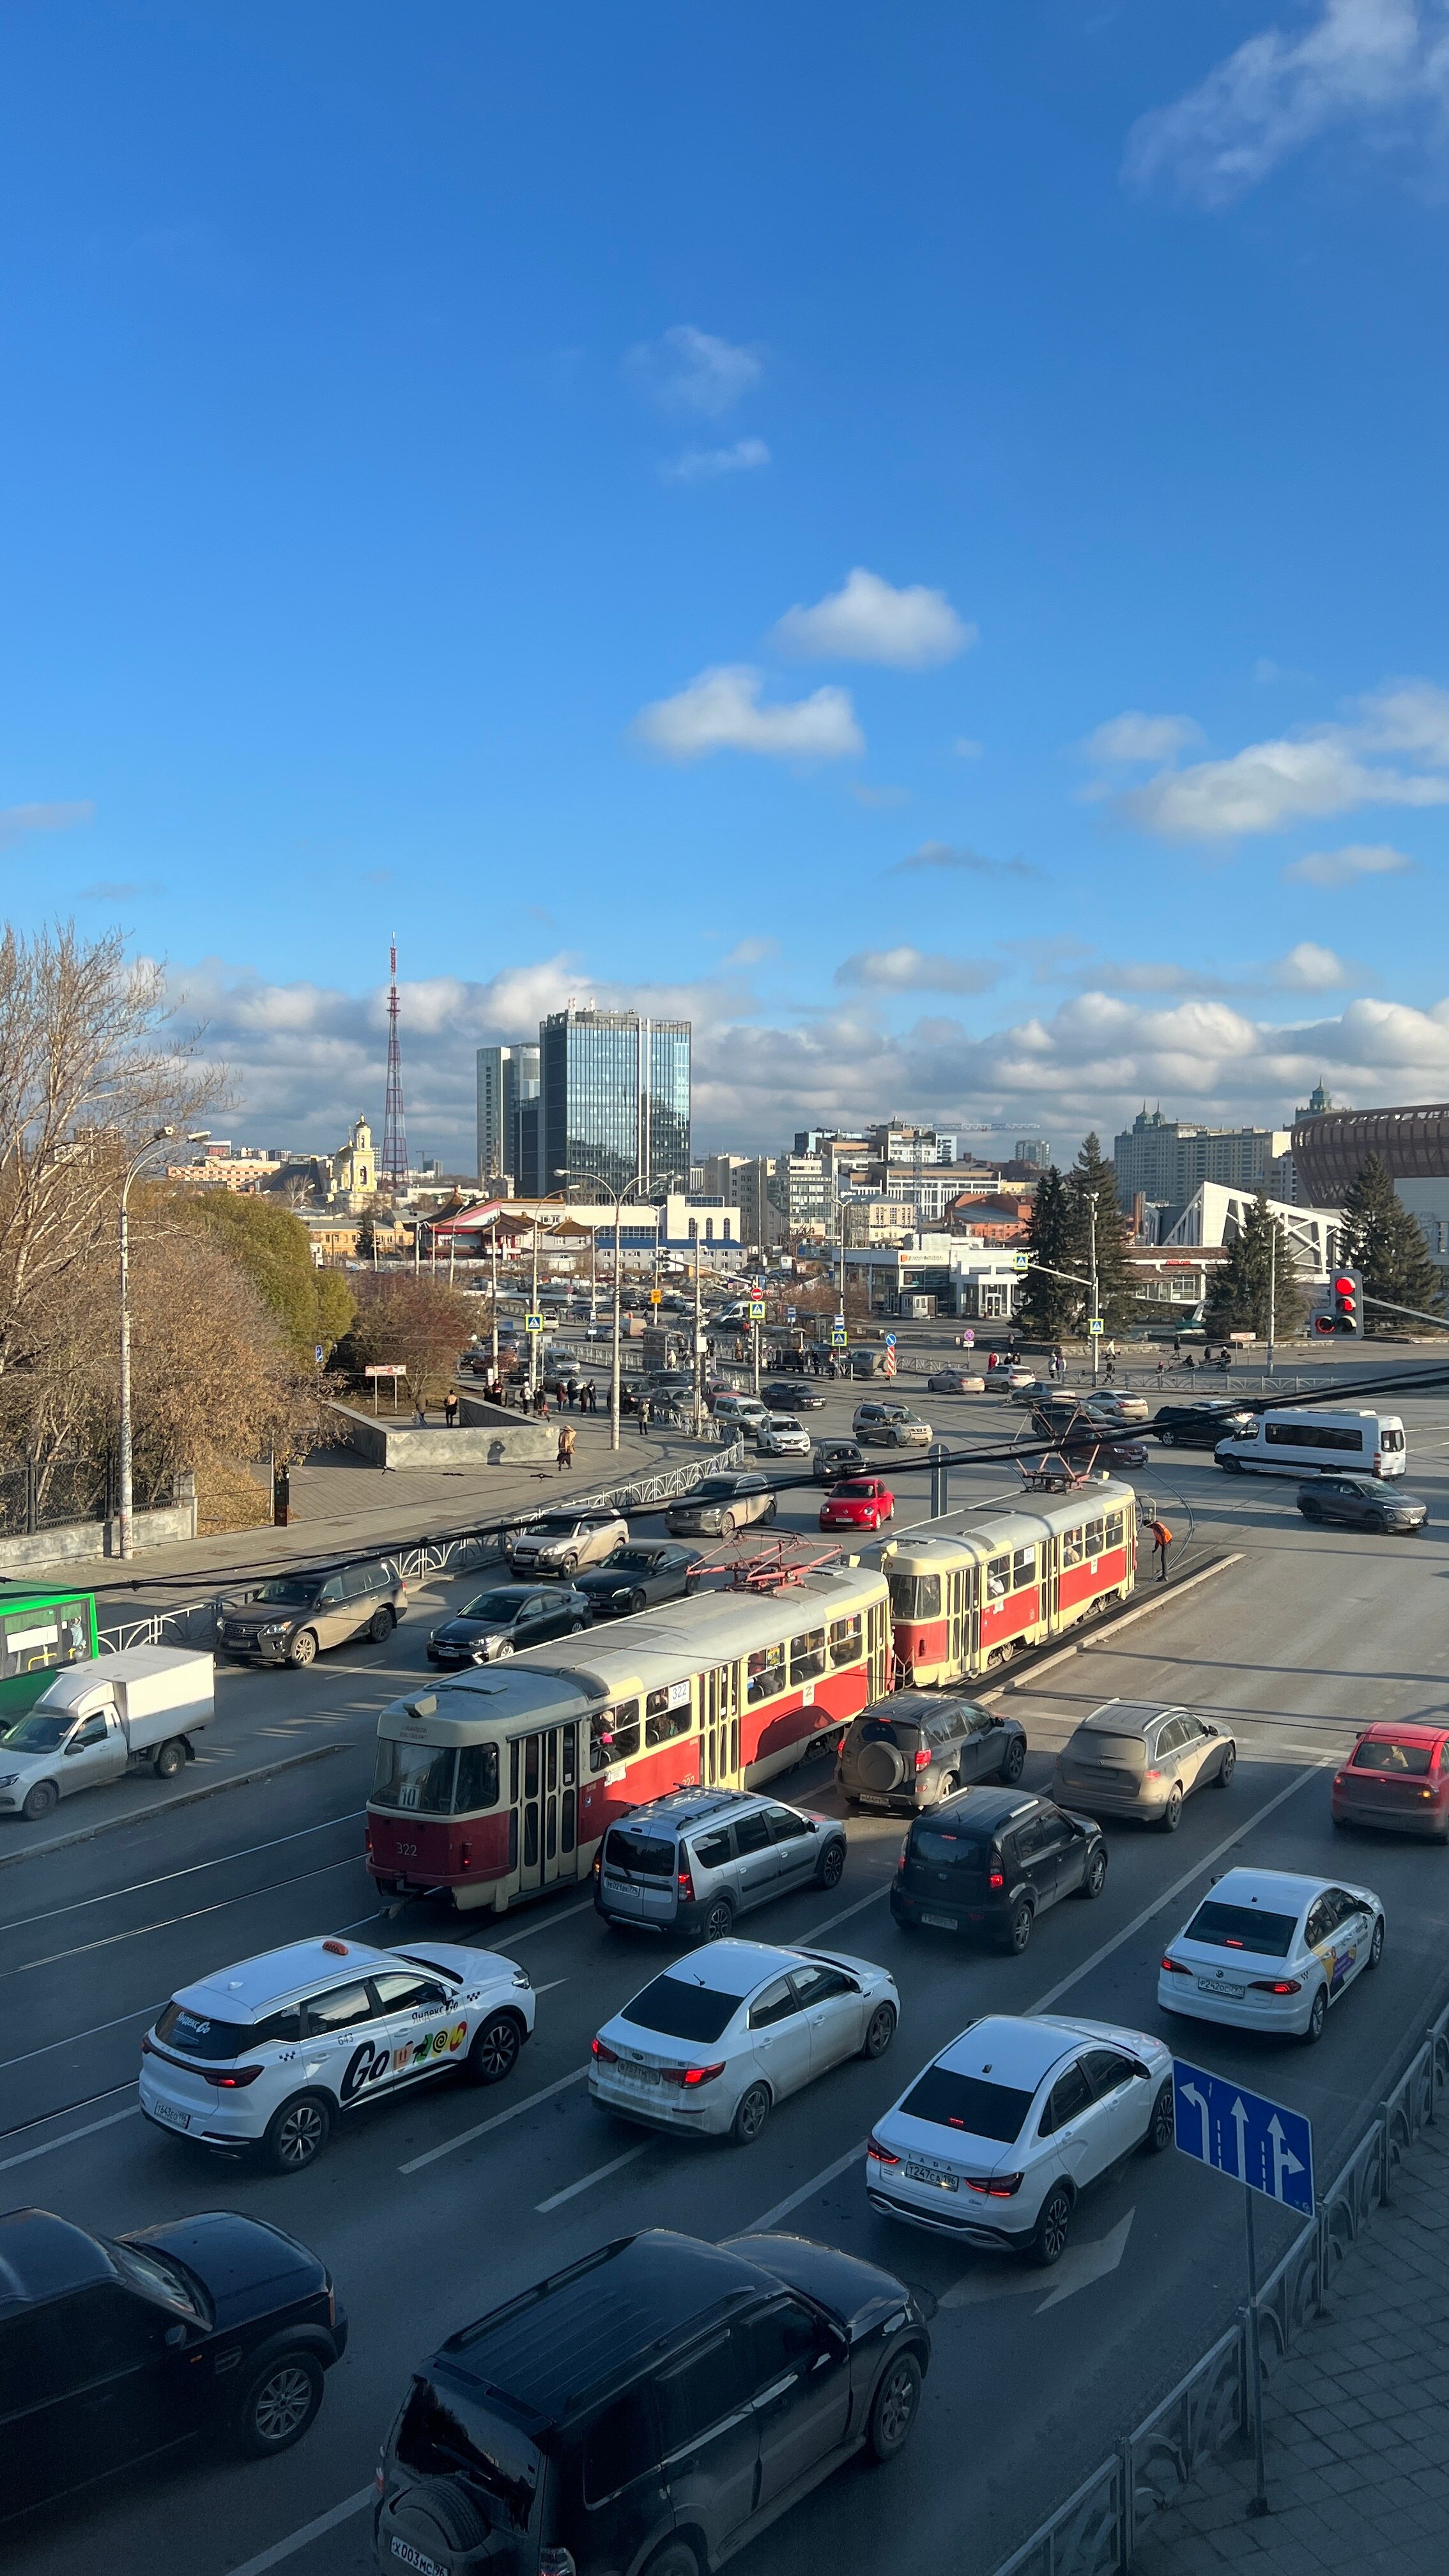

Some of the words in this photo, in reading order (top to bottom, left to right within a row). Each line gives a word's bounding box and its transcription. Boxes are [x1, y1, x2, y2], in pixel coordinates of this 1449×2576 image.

[673, 1683, 687, 1700] 322
[402, 1787, 416, 1807] 10
[395, 1842, 418, 1857] 322
[411, 2006, 445, 2024] Яндекс
[445, 2000, 458, 2016] Go
[176, 2011, 200, 2029] Яндекс
[196, 2021, 210, 2034] Go
[338, 2032, 353, 2045] 643
[340, 2039, 390, 2101] Go
[908, 2153, 952, 2172] LADA
[909, 2166, 941, 2182] Т247СА
[394, 2542, 433, 2575] Х003МС
